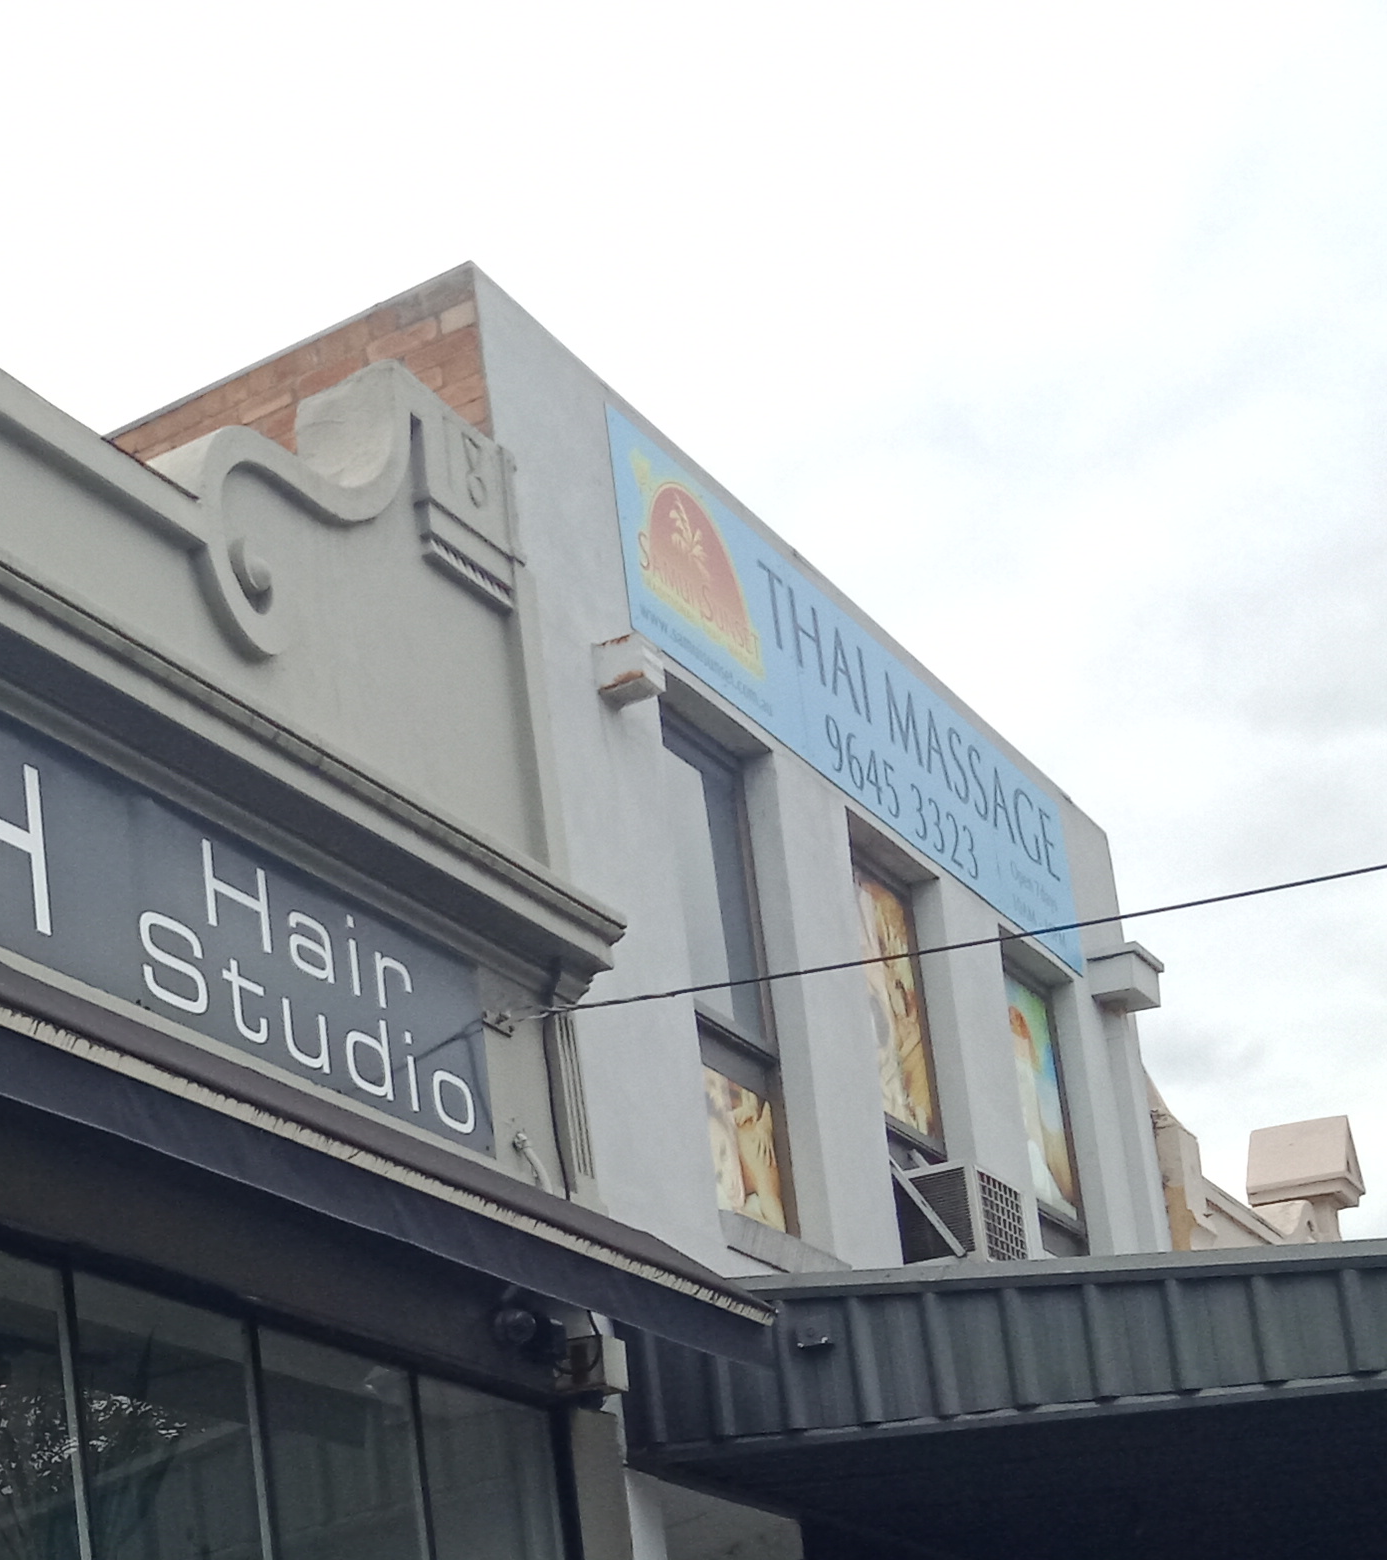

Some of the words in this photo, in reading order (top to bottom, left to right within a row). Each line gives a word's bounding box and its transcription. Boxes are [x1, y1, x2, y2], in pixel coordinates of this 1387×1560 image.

[757, 559, 872, 725] THAI
[884, 670, 1061, 882] MASSAGE
[825, 714, 900, 820] 9645
[910, 782, 979, 880] 3323
[202, 838, 413, 1009] Hair
[139, 911, 476, 1134] Studio
